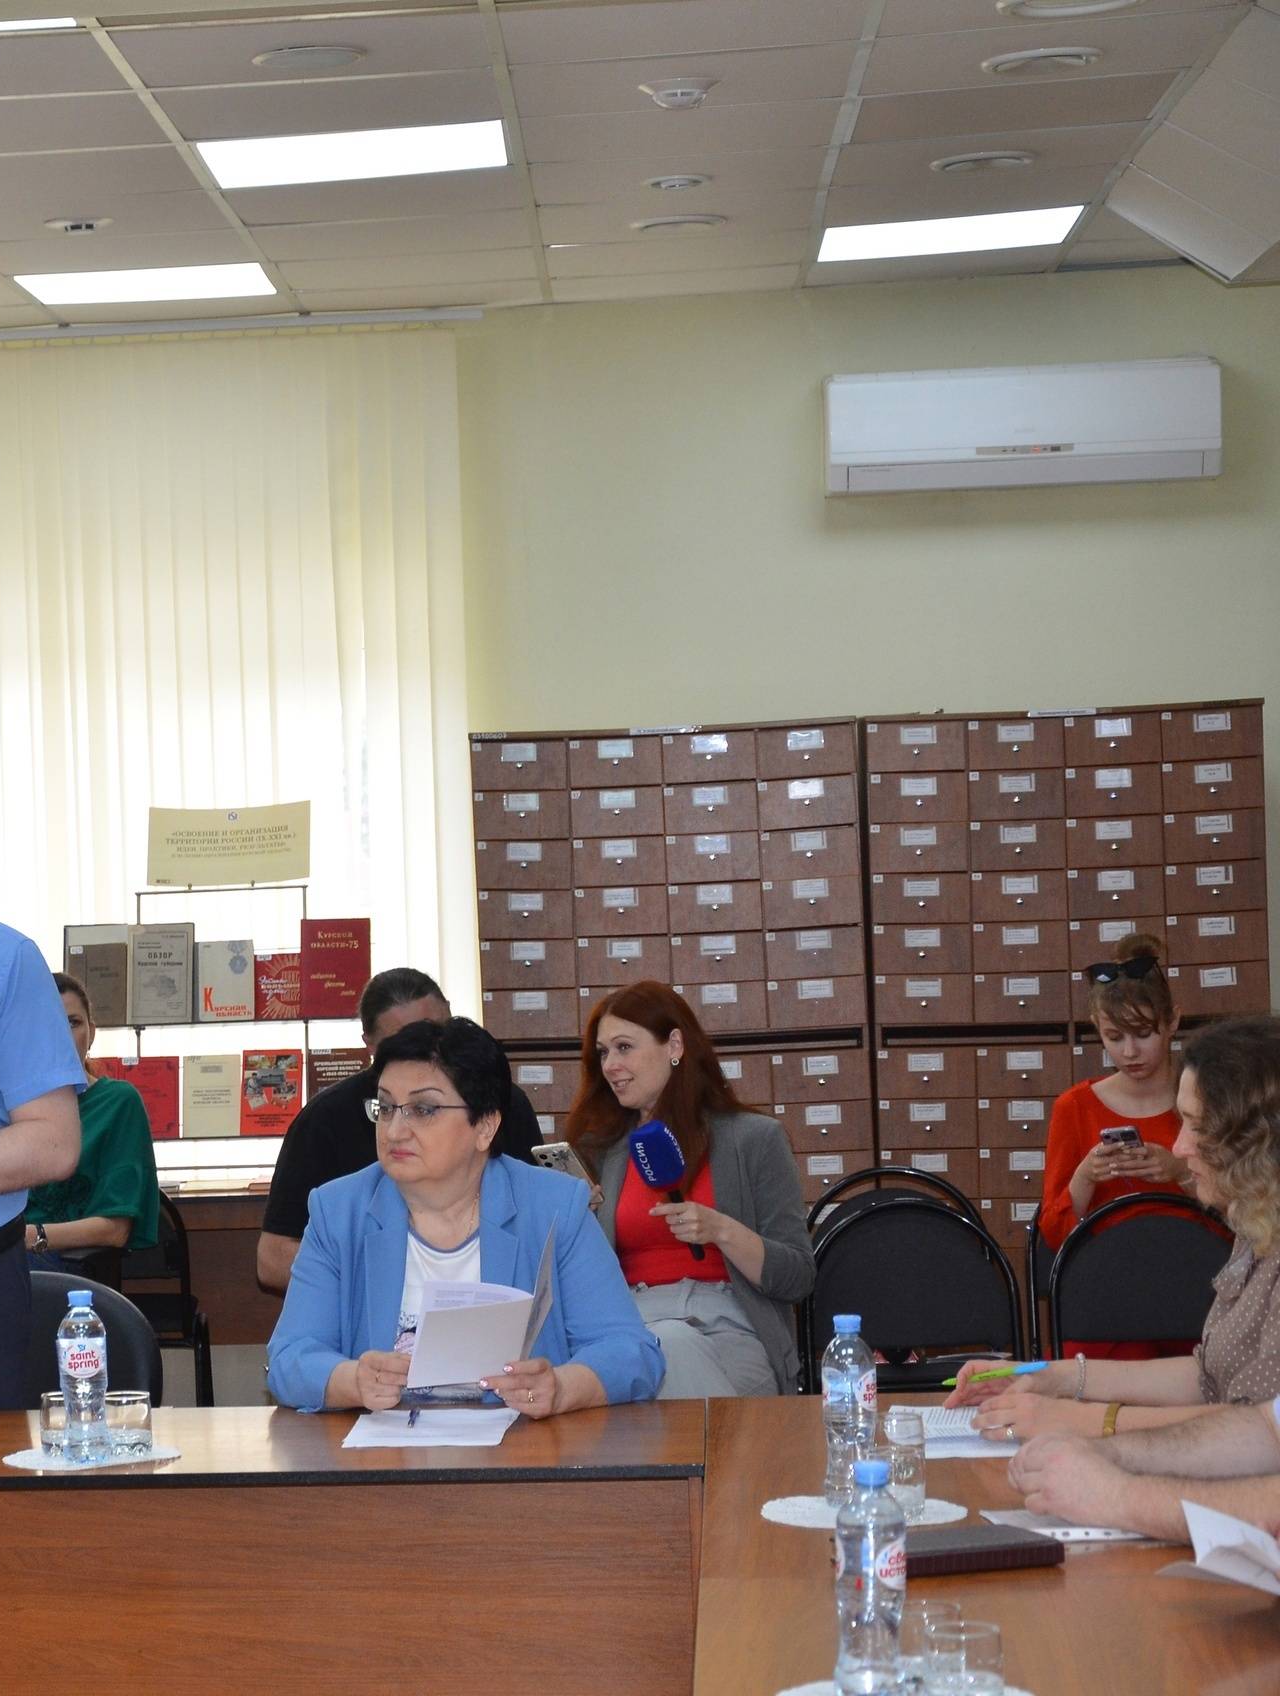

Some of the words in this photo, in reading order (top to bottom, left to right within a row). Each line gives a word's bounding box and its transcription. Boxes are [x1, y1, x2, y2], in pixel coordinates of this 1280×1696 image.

[229, 825, 289, 836] ОРГАНИЗАЦИЯ
[221, 836, 252, 844] РОССИИ
[147, 952, 173, 960] ОБЗОР
[635, 1142, 657, 1182] РОССИЯ
[70, 1350, 96, 1361] saint
[68, 1359, 100, 1371] spring
